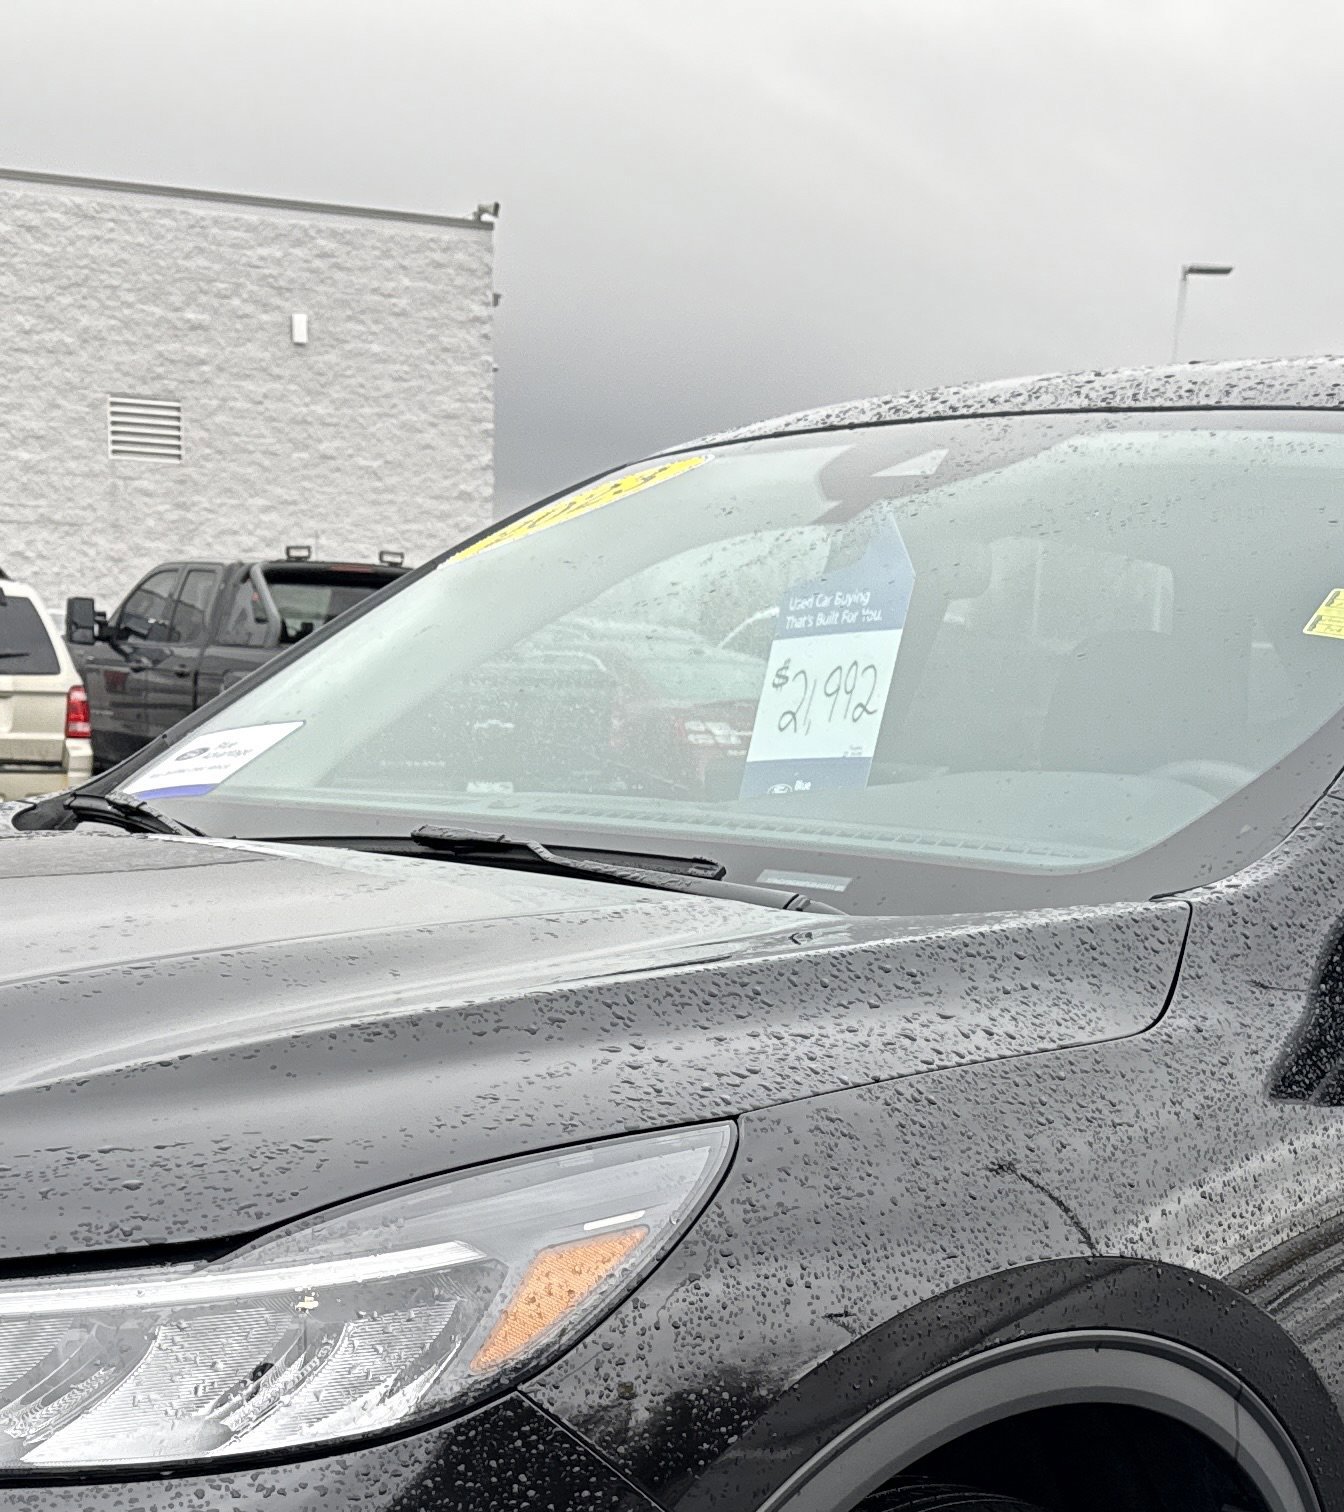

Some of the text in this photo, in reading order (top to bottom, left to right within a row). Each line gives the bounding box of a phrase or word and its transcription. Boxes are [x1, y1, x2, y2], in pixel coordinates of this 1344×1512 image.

[789, 591, 871, 611] Used Car Buying
[786, 614, 814, 630] That's
[816, 611, 838, 627] Built
[841, 610, 858, 624] For
